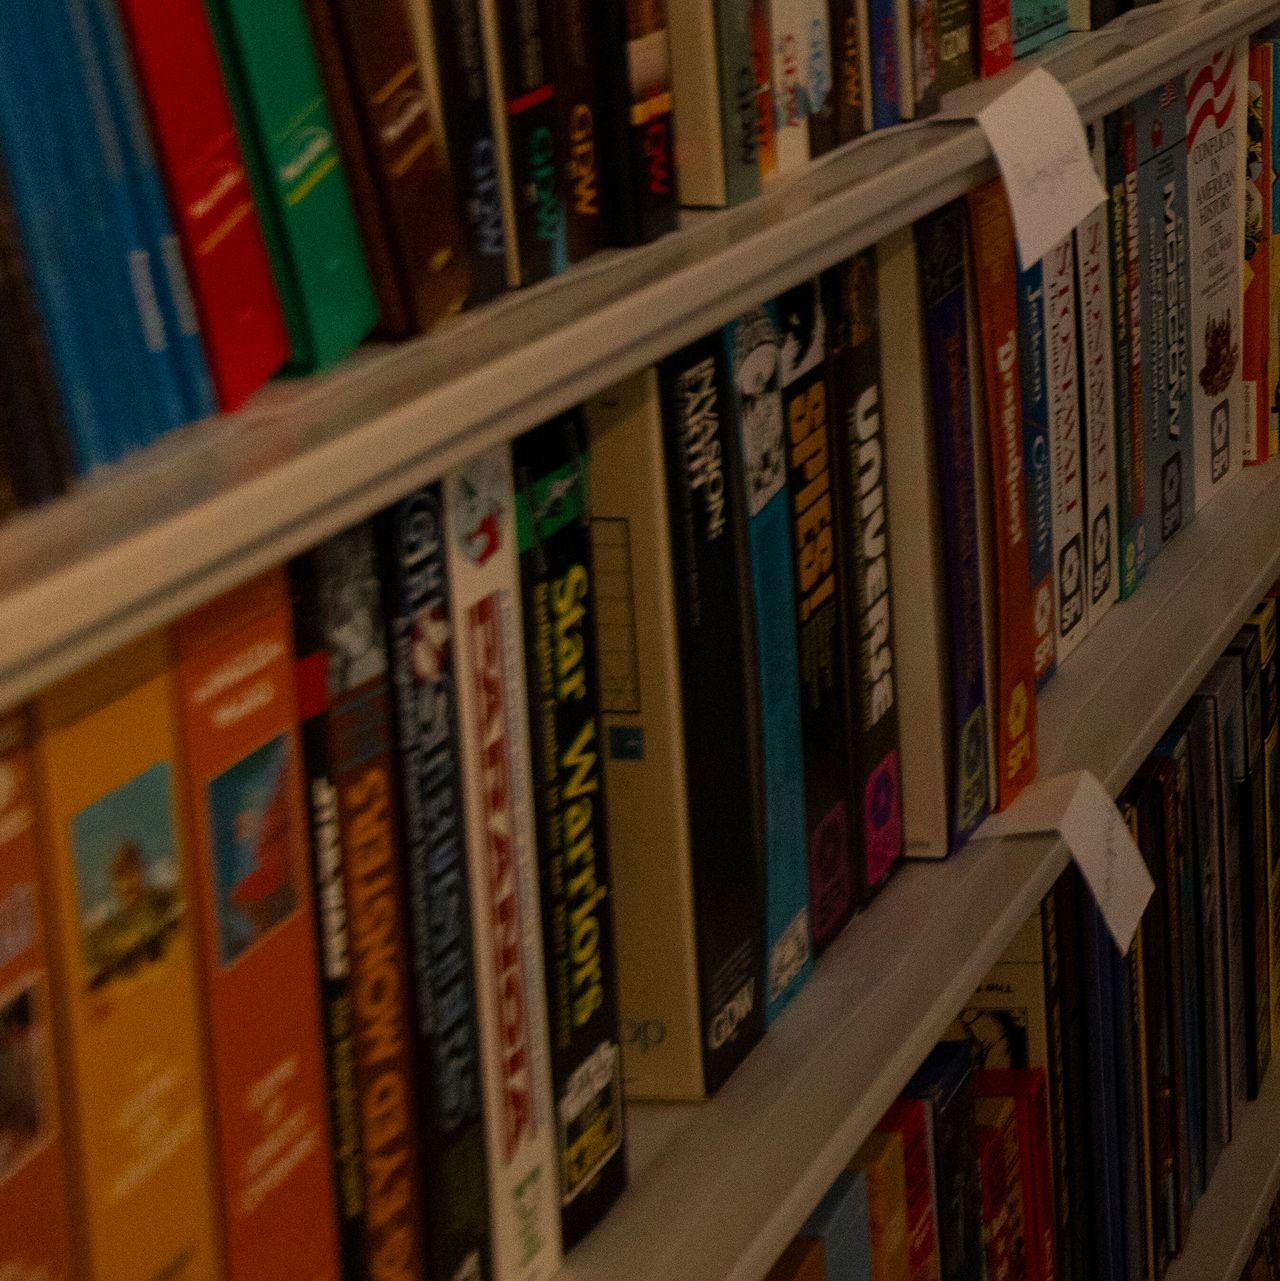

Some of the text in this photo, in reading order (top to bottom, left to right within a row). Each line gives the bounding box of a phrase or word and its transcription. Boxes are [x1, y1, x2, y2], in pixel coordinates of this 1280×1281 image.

[1192, 126, 1235, 164] CONFLICTS
[1196, 171, 1236, 205] AMERICAN
[1210, 156, 1220, 174] IN
[855, 383, 896, 733] UNIVERSE
[548, 561, 609, 1030] Star Warriors
[343, 766, 406, 1064] MONSTERS
